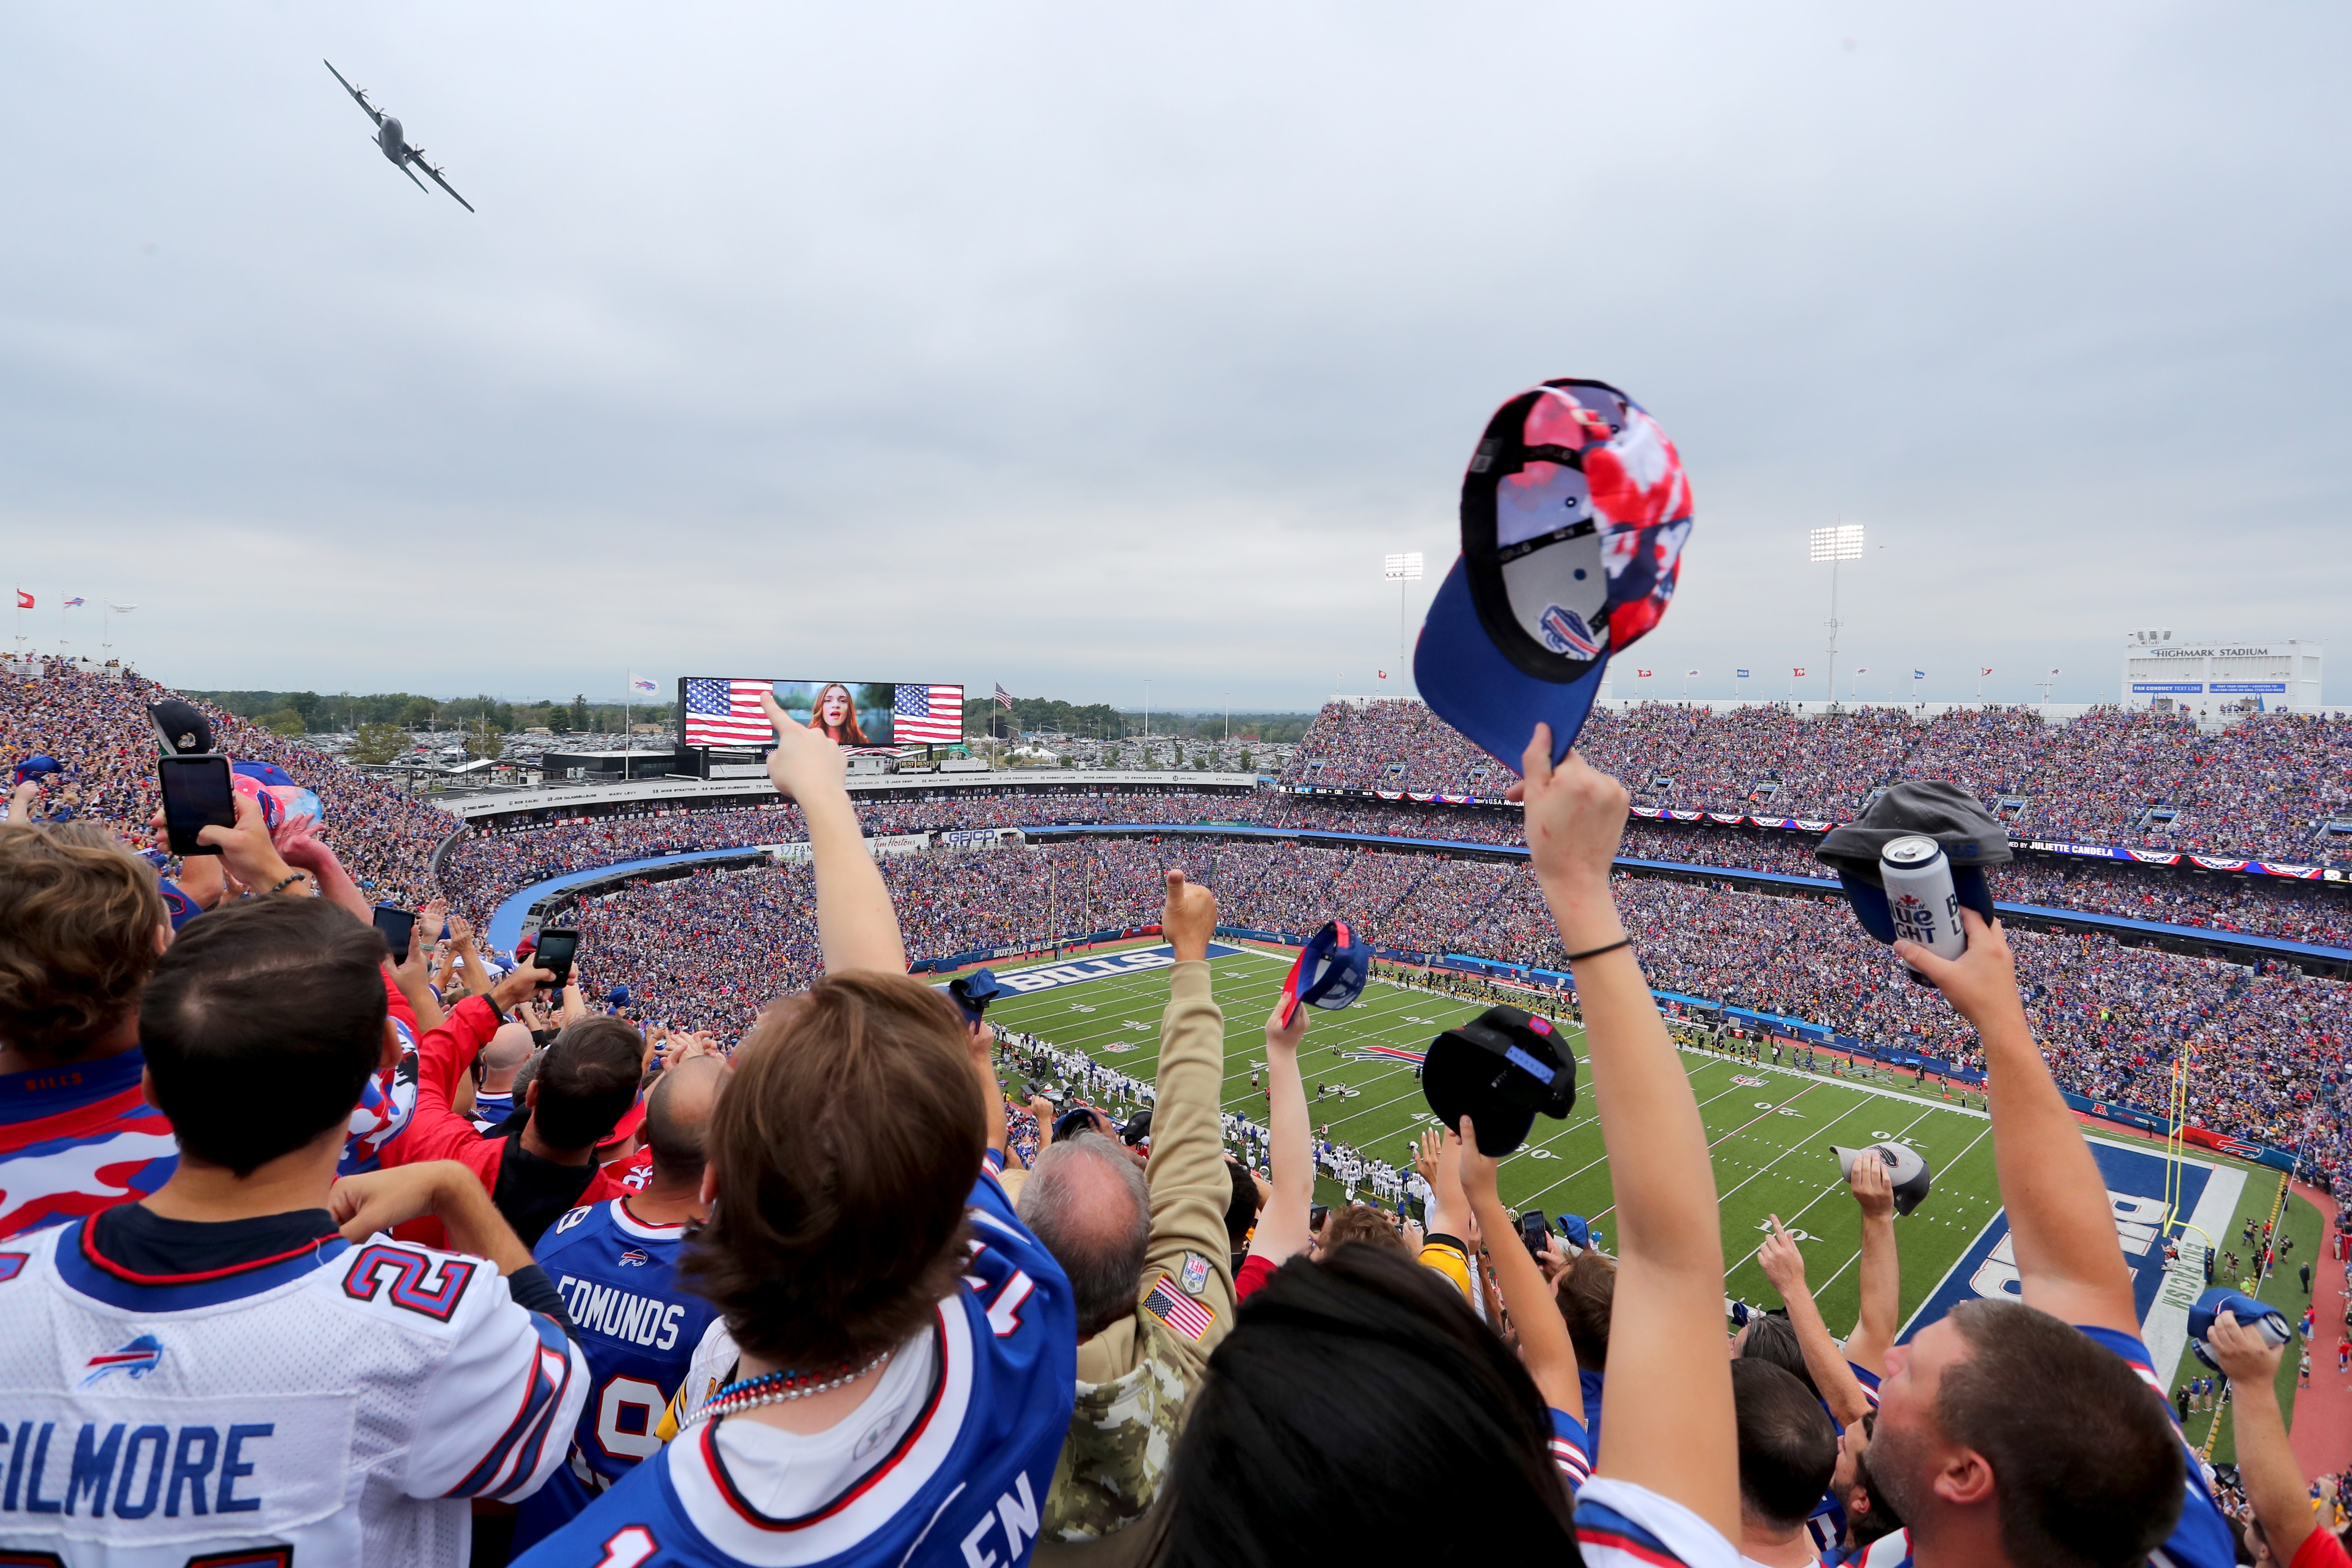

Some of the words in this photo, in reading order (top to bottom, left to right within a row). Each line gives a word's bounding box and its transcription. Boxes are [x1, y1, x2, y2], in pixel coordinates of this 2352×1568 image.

[2157, 649, 2214, 657] HIGHMARK
[874, 838, 887, 848] Tim
[888, 837, 916, 847] Hortons
[949, 830, 995, 843] GEICO
[2029, 841, 2070, 852] JULIETTE
[2072, 845, 2114, 857] CANDELA
[1896, 922, 1936, 944] GHT
[993, 945, 1027, 958] BUFFALO
[1030, 941, 1053, 952] BILLS
[995, 952, 1176, 992] BILLS
[1069, 1003, 1097, 1013] 10
[1121, 1020, 1152, 1031] 20
[1406, 1016, 1436, 1025] 40
[24, 1072, 83, 1091] BILLS
[1735, 1078, 1757, 1086] NFL
[1324, 1084, 1361, 1098] 50
[1754, 1102, 1799, 1116] 20
[1410, 1113, 1446, 1126] 40
[1871, 1130, 1918, 1146] 10
[1514, 1142, 1551, 1159] 30
[1754, 1218, 1809, 1241] 10
[2181, 1242, 2206, 1265] END
[1190, 1259, 1205, 1275] NFL
[341, 1243, 477, 1323] 2
[2161, 1263, 2202, 1311] RACISM
[556, 1274, 685, 1351] EDMUNDS
[0, 1421, 275, 1520] ILMORE
